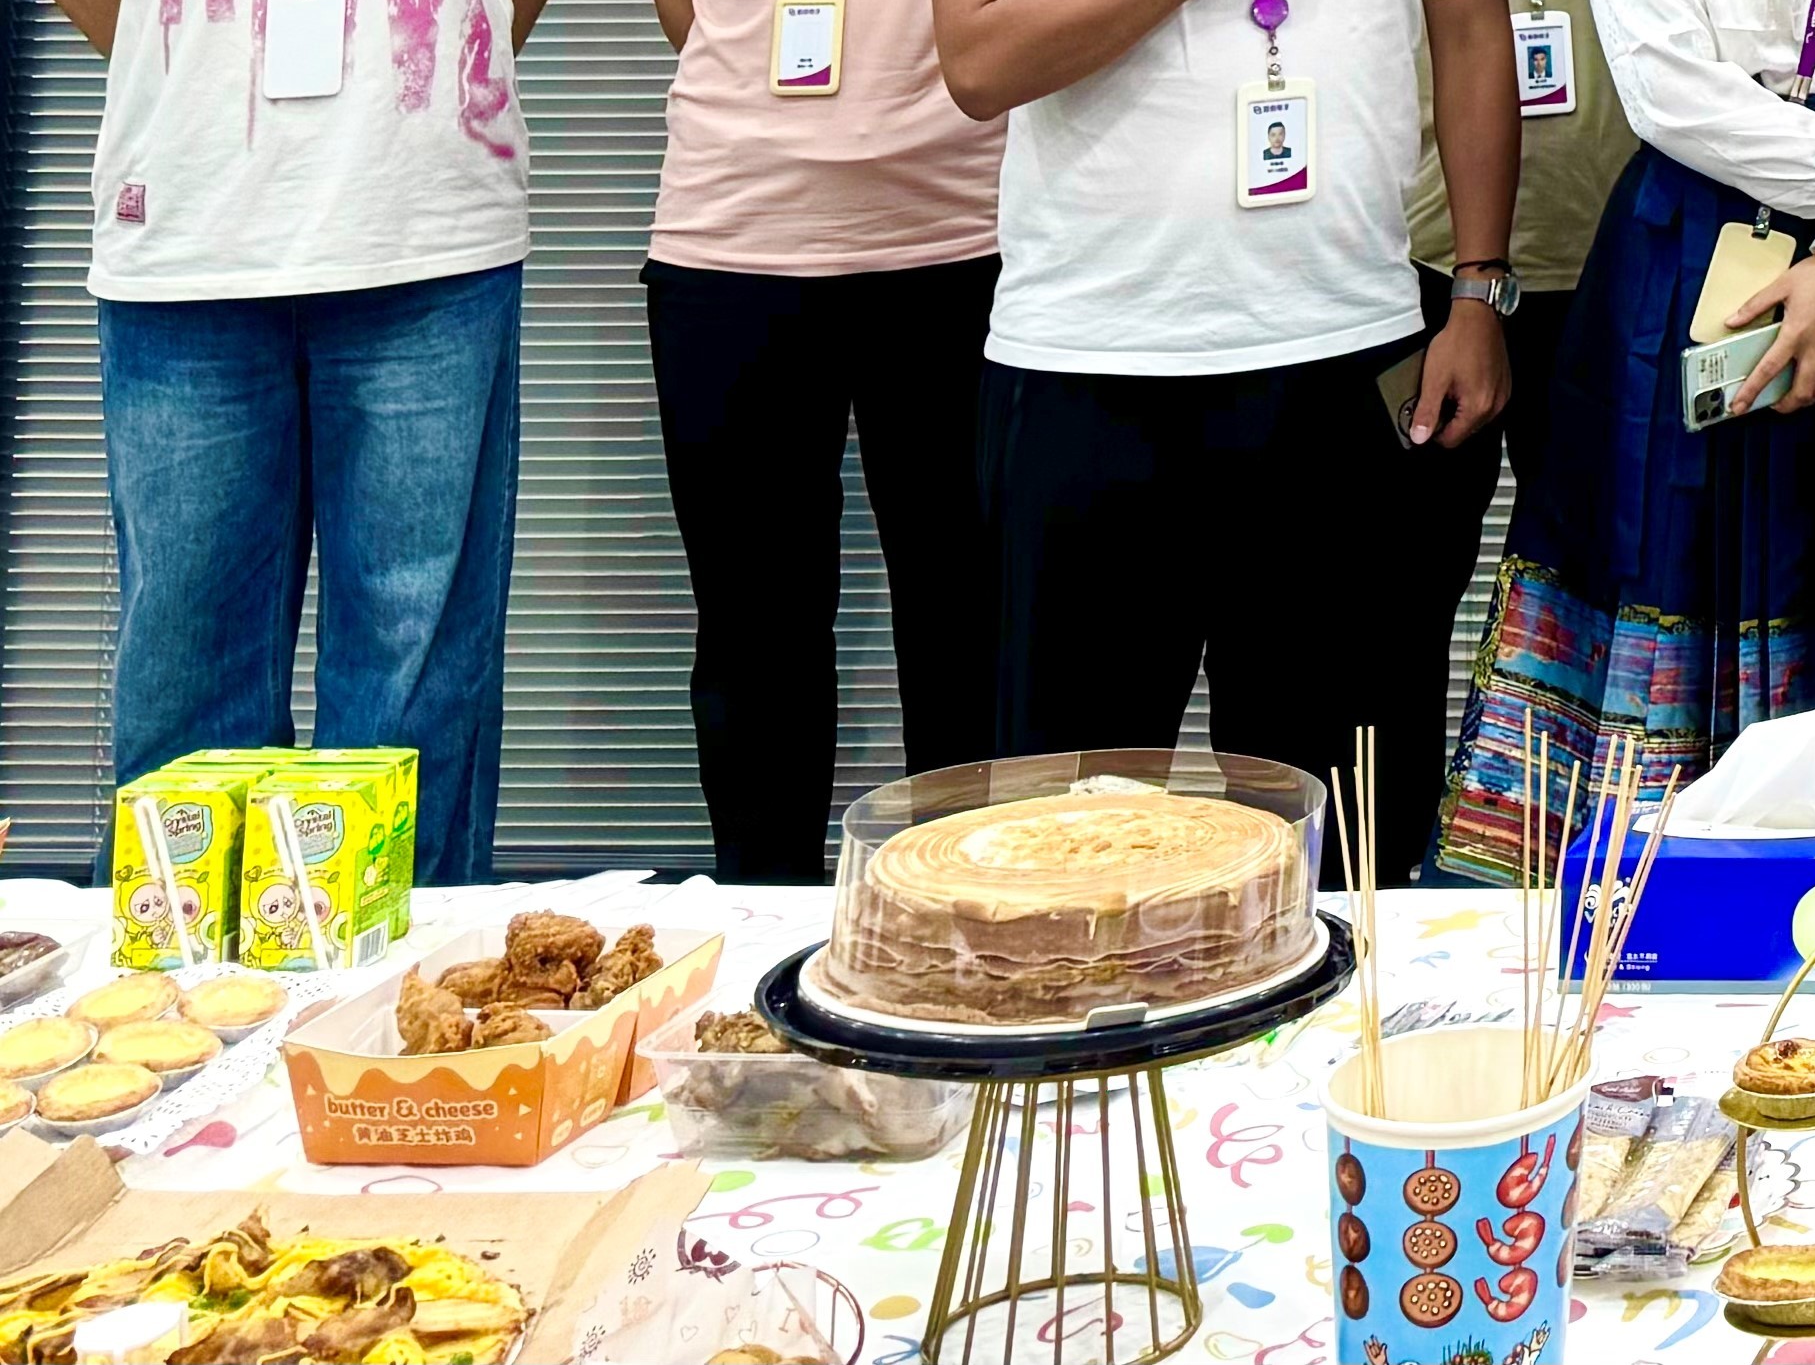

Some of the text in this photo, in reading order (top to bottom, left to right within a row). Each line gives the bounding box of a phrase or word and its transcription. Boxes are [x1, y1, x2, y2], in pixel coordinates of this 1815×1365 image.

[325, 1098, 497, 1119] butter & cheese
